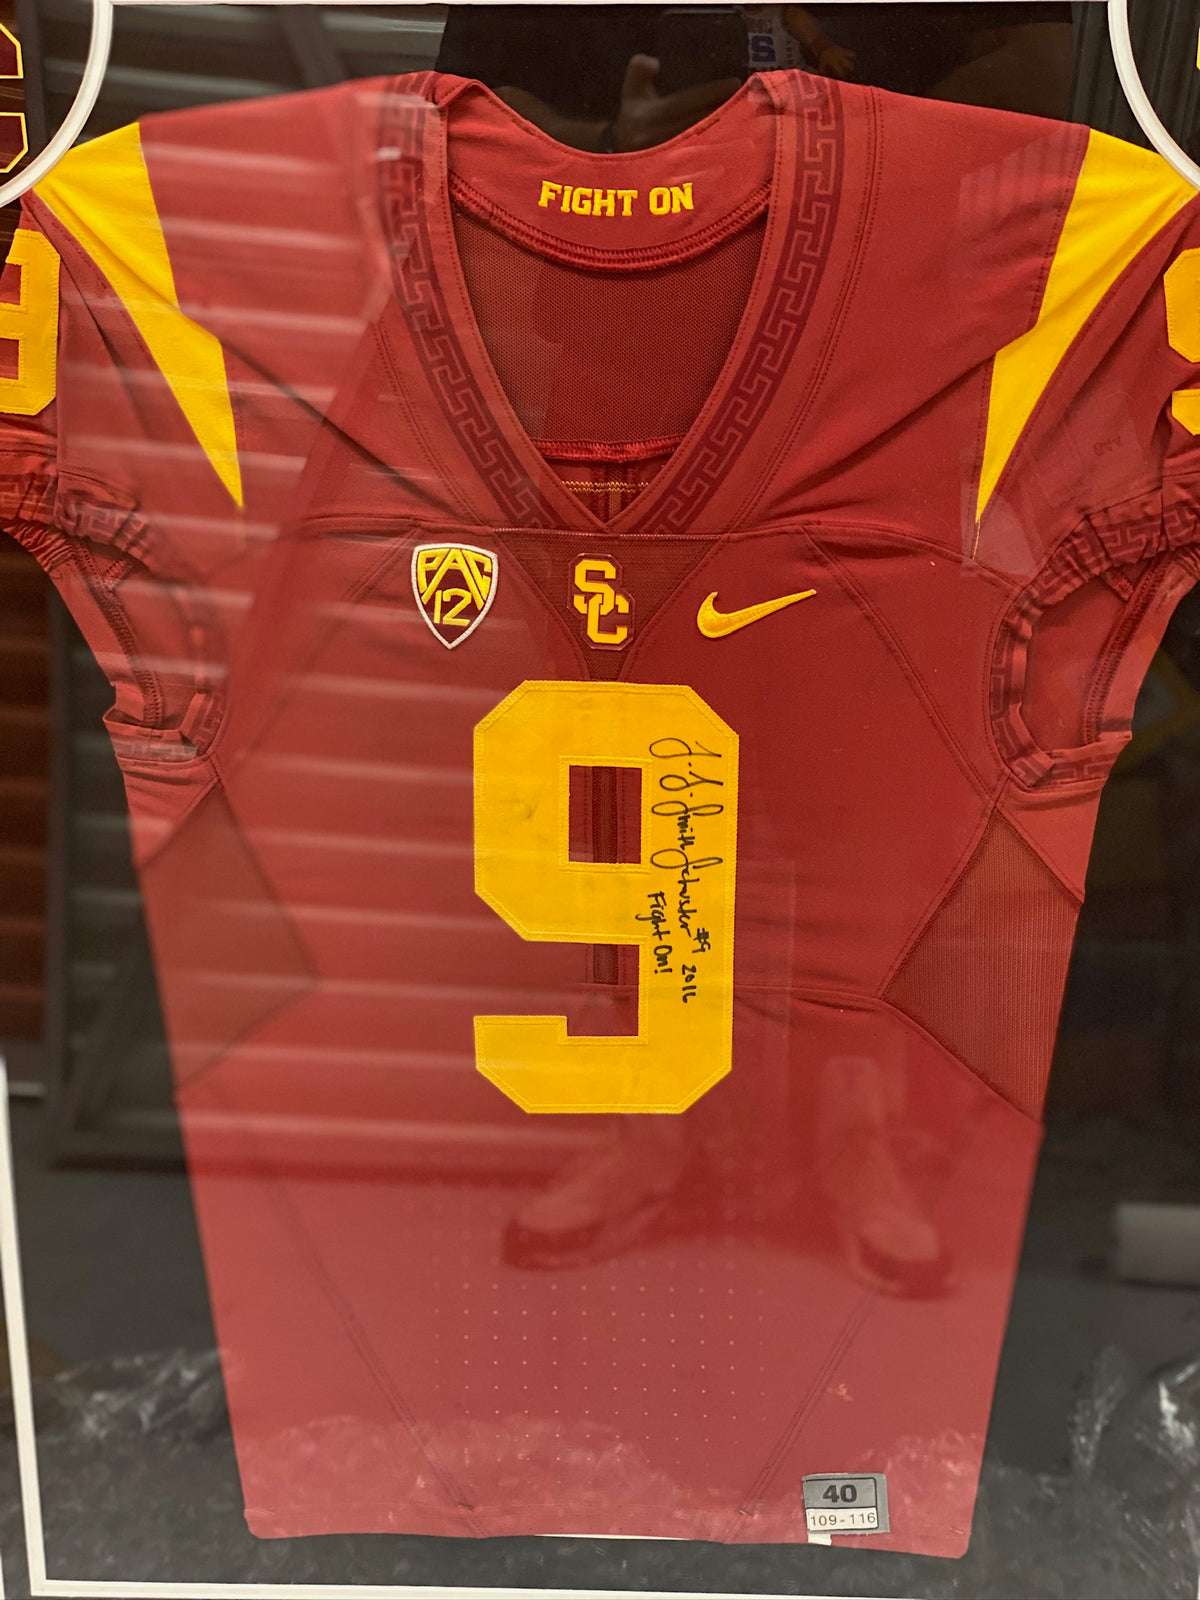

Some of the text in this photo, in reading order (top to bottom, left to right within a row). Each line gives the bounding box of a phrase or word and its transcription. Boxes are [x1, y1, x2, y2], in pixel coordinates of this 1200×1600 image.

[538, 180, 694, 217] FIGHT ON
[417, 548, 491, 610] PAC
[434, 588, 471, 626] 12
[473, 679, 739, 1114] 9
[635, 891, 674, 975] Fight On!
[681, 964, 698, 1005] 2016
[822, 1484, 857, 1503] 40
